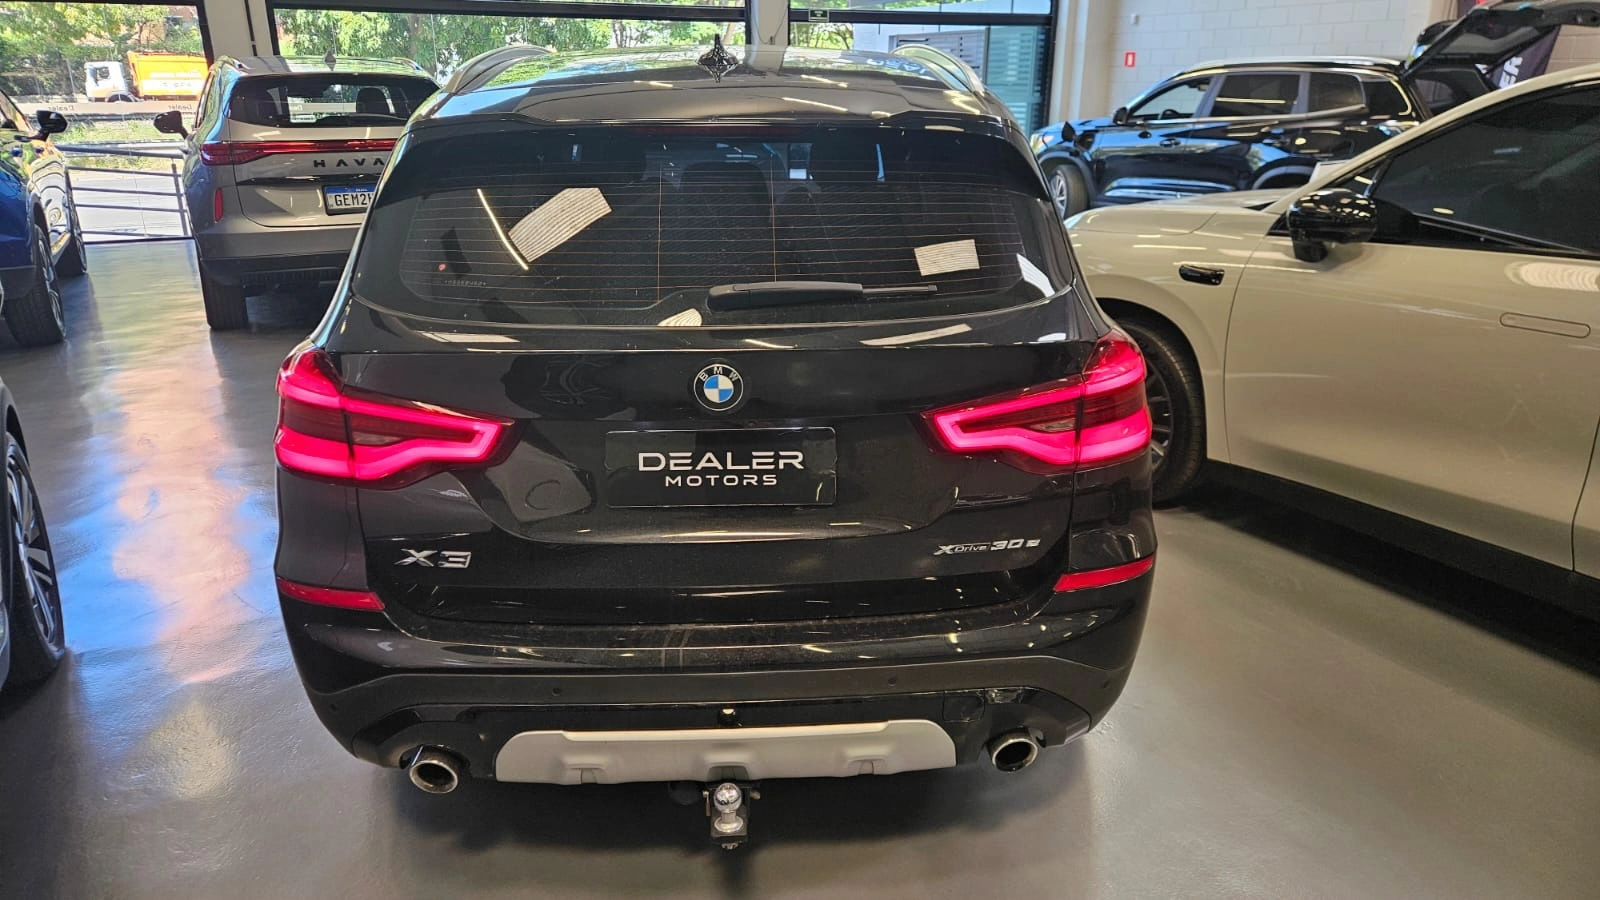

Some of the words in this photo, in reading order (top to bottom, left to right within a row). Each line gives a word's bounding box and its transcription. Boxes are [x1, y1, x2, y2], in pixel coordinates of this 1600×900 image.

[698, 365, 740, 382] BMW
[638, 450, 805, 471] DEALER
[665, 474, 778, 487] MOTORS
[394, 548, 472, 568] X3
